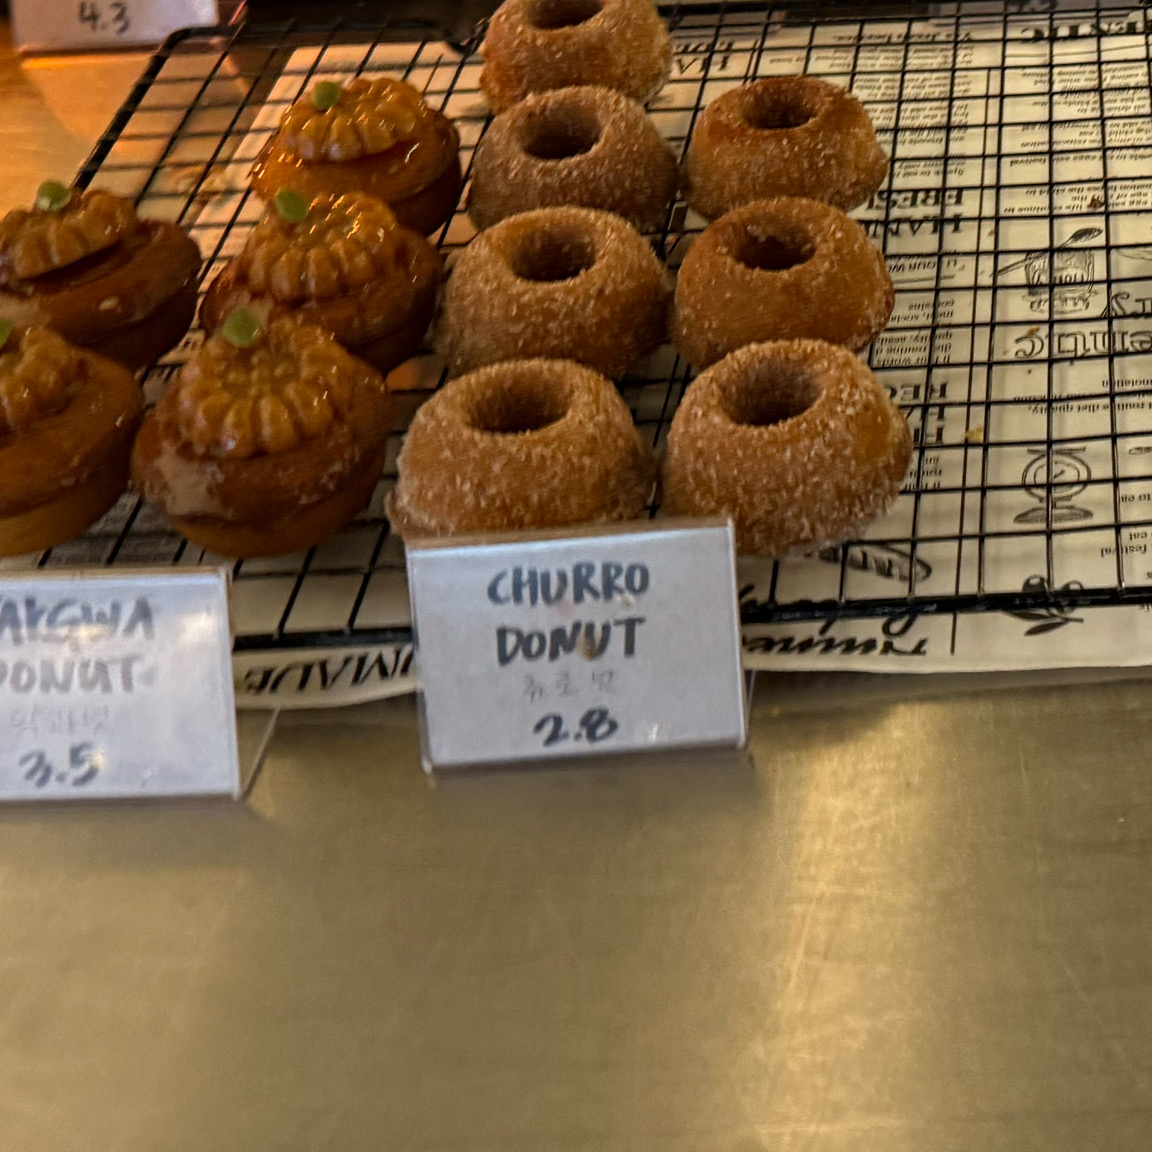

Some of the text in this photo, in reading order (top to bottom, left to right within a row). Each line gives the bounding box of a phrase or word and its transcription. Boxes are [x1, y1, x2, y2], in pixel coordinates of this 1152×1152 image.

[79, 1, 130, 35] 4.3
[1077, 403, 1100, 415] diet
[1138, 492, 1151, 502] to
[488, 561, 649, 608] CHURRO
[497, 617, 646, 667] DONUT
[534, 706, 618, 747] 2.8
[19, 741, 100, 788] 3.5
